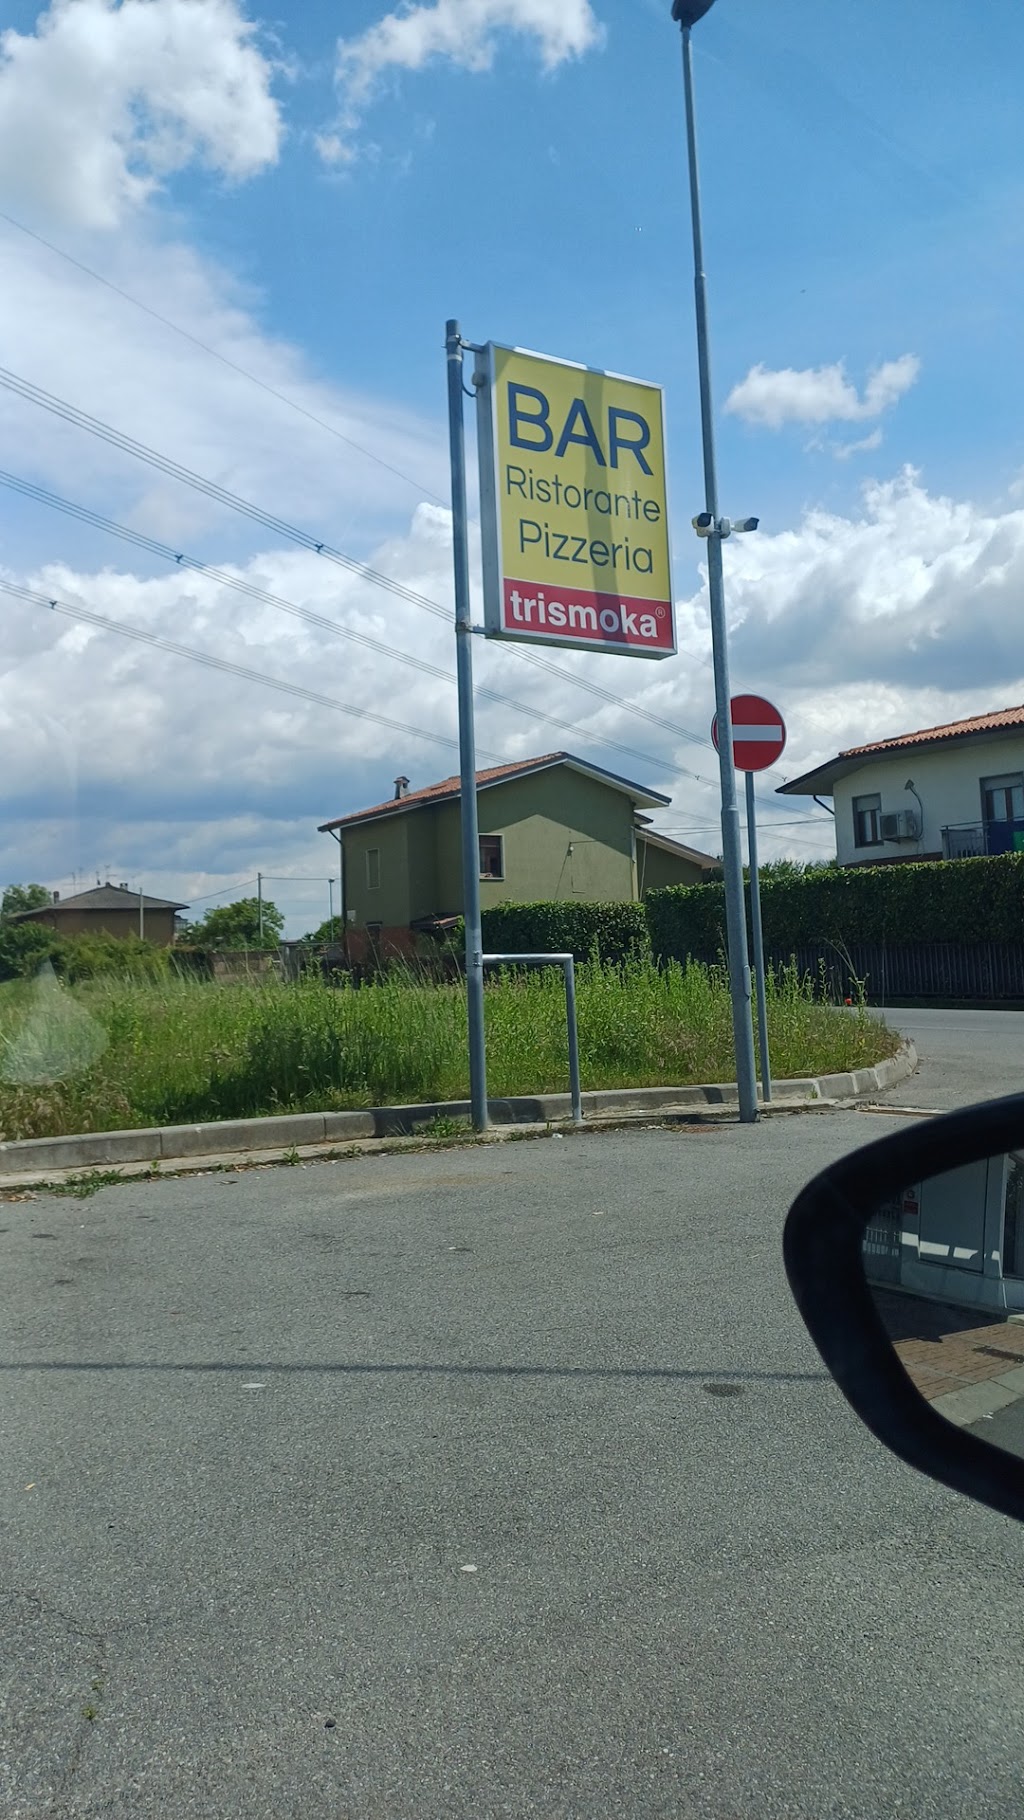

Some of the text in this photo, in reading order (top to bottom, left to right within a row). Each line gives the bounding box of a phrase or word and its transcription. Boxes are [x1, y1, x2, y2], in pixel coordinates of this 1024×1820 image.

[507, 381, 654, 476] BAR
[506, 464, 661, 523] Ristorante
[519, 518, 654, 574] Pizzeria
